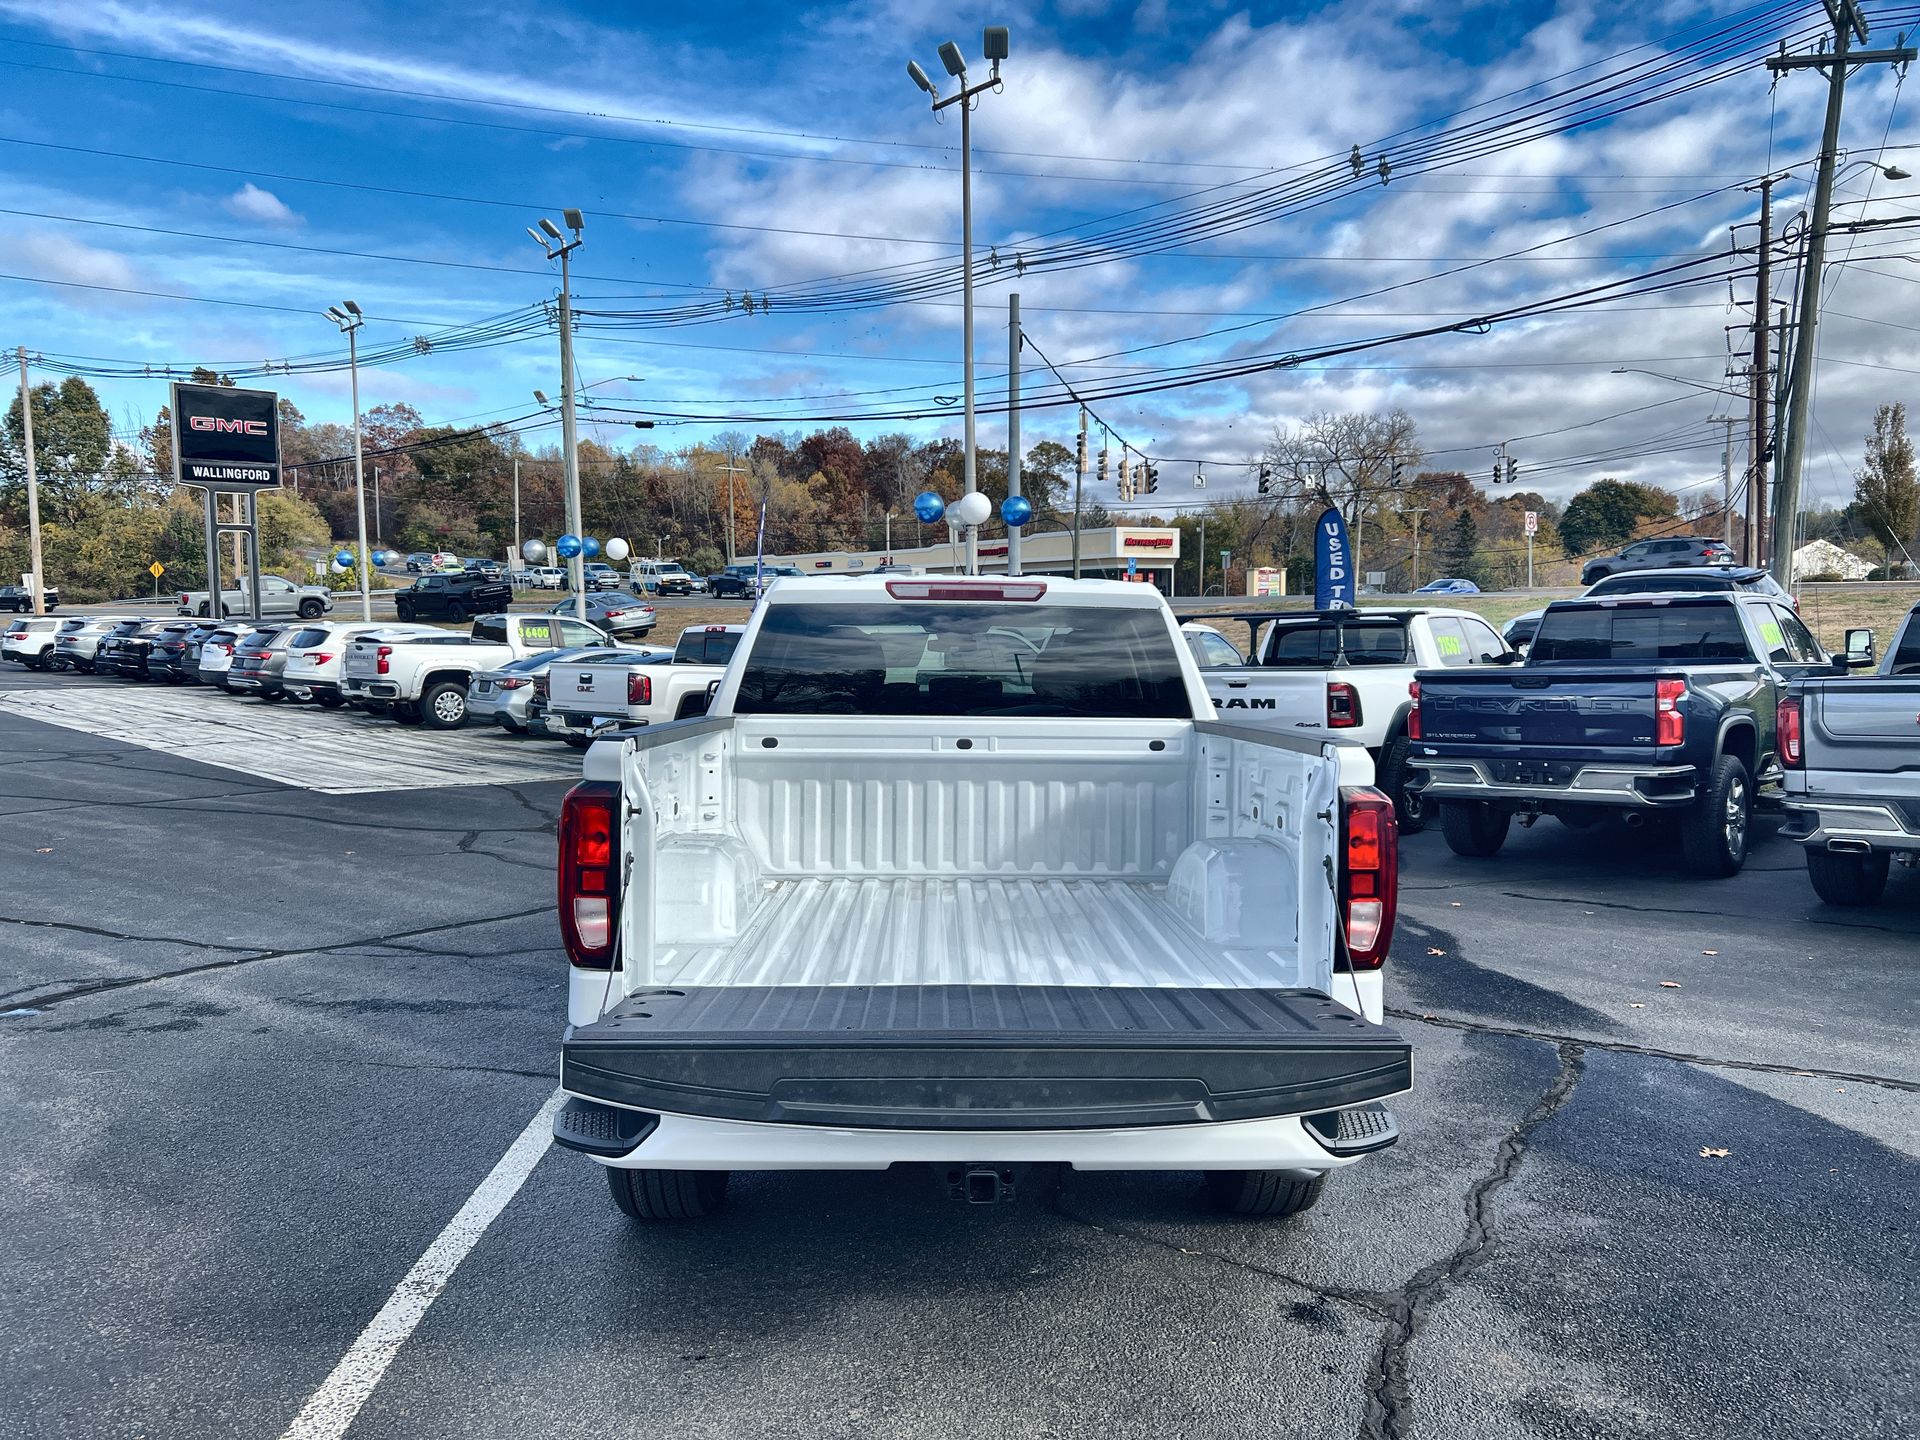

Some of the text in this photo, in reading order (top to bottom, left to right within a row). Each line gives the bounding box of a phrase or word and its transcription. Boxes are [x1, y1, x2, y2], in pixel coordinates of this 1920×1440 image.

[190, 415, 268, 436] GMC
[192, 465, 271, 481] WALLINGFORD
[1324, 522, 1345, 581] USED
[576, 685, 595, 693] GMC
[1211, 698, 1276, 709] RAM
[1433, 697, 1640, 713] CHEVROLET
